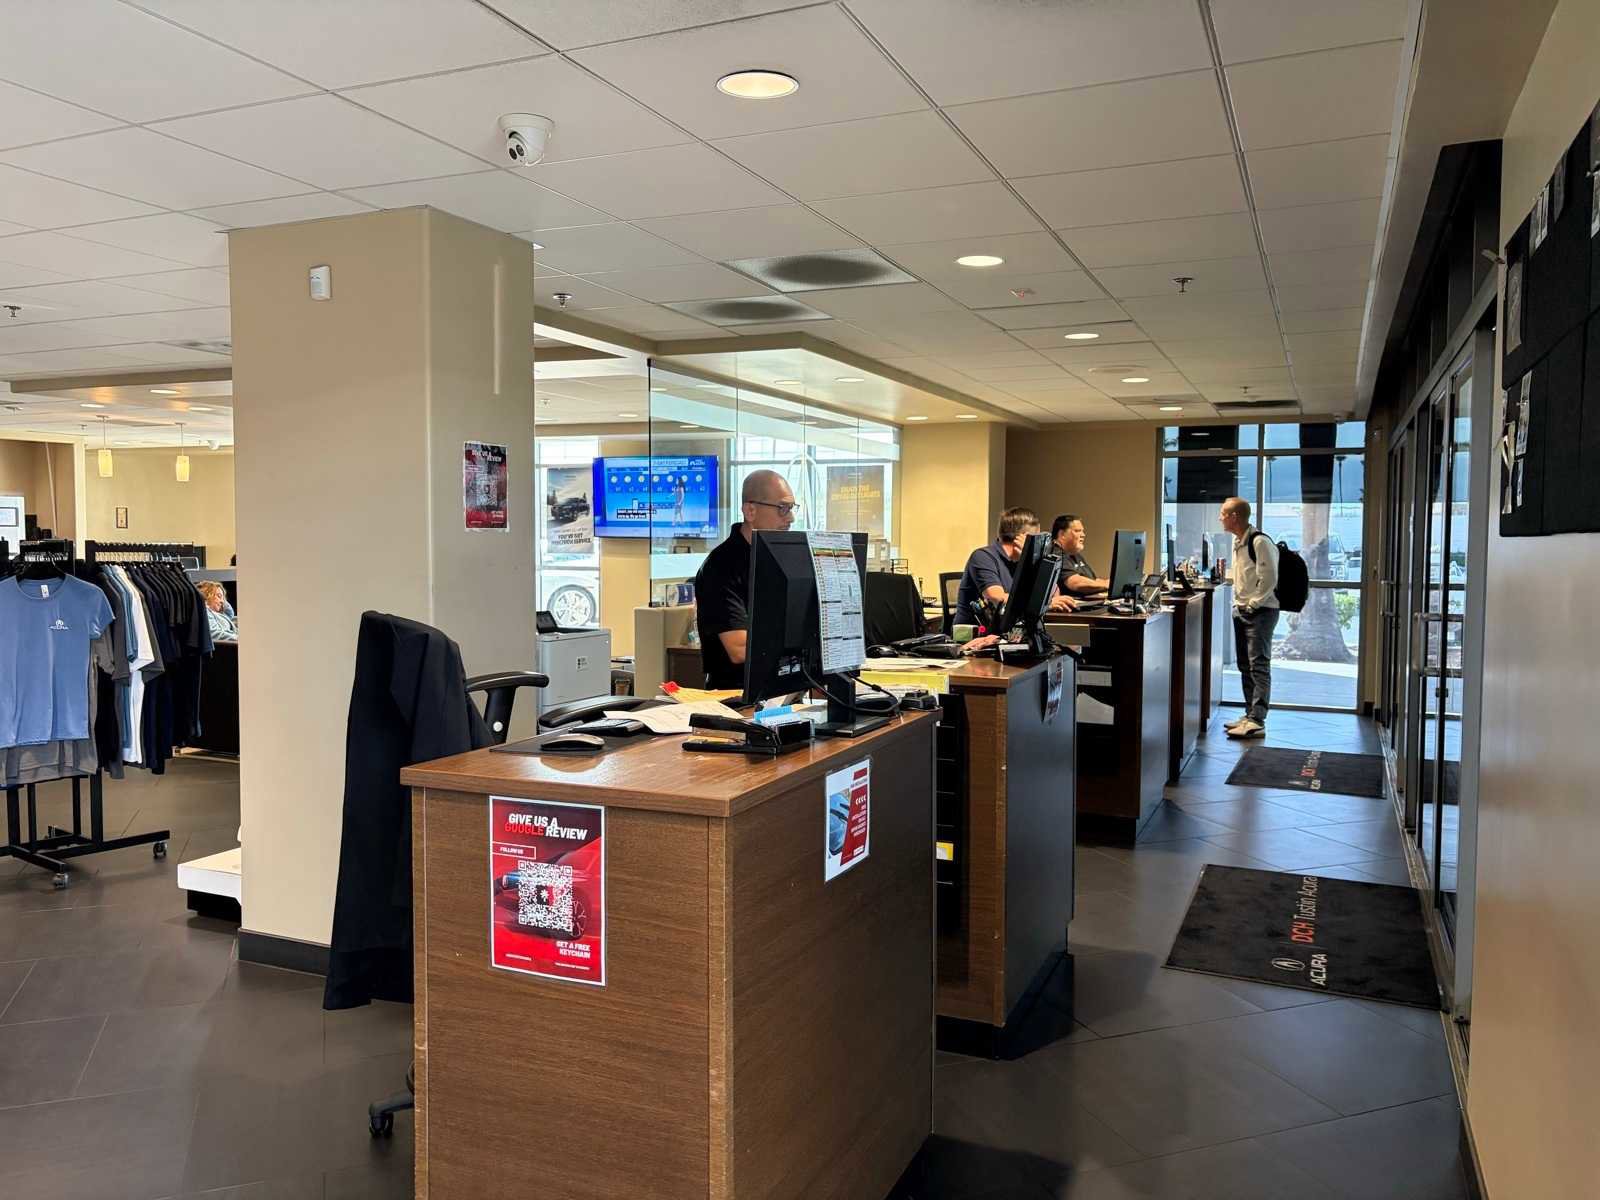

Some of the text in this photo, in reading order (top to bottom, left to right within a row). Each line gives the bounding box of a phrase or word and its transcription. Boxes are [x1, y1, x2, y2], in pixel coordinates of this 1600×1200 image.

[508, 813, 559, 828] GIVE US A
[504, 822, 588, 840] GOOGLE REVIEW
[1290, 876, 1319, 943] DCH Tustin Acura
[559, 948, 591, 959] KEYCHAIN
[1310, 953, 1328, 986] ACURA
